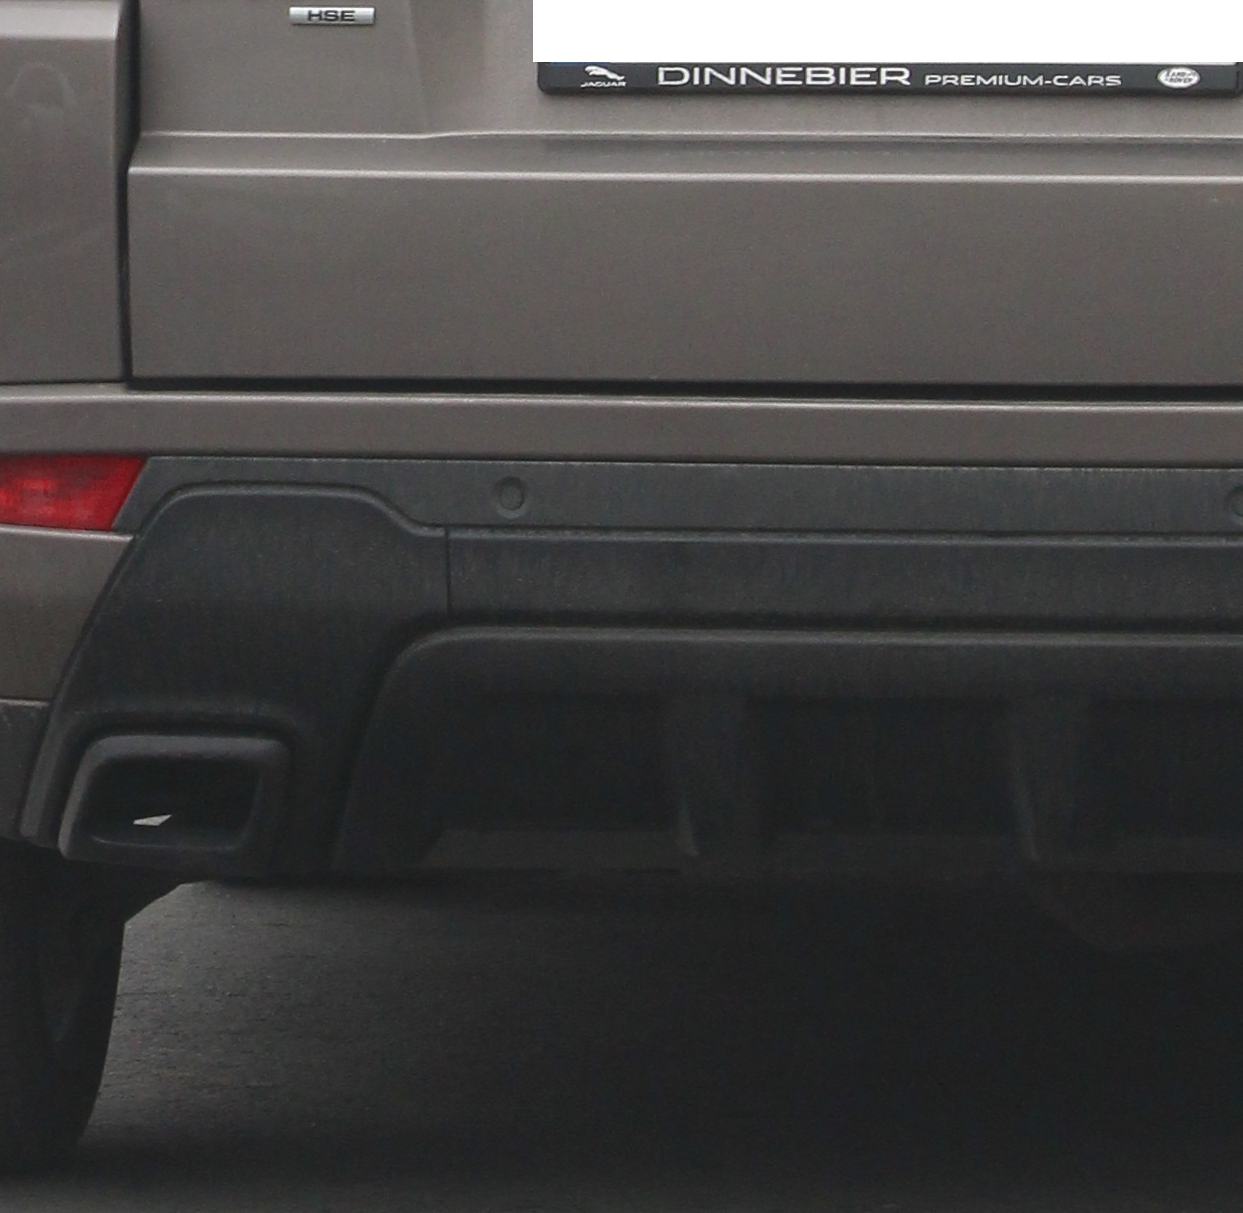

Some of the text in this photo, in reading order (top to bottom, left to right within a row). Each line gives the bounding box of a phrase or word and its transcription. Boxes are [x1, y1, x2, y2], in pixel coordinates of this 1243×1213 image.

[307, 9, 357, 23] HSE
[657, 66, 1123, 87] DINNEBIER PREMIUM-CARS
[580, 80, 627, 88] JAGUAR
